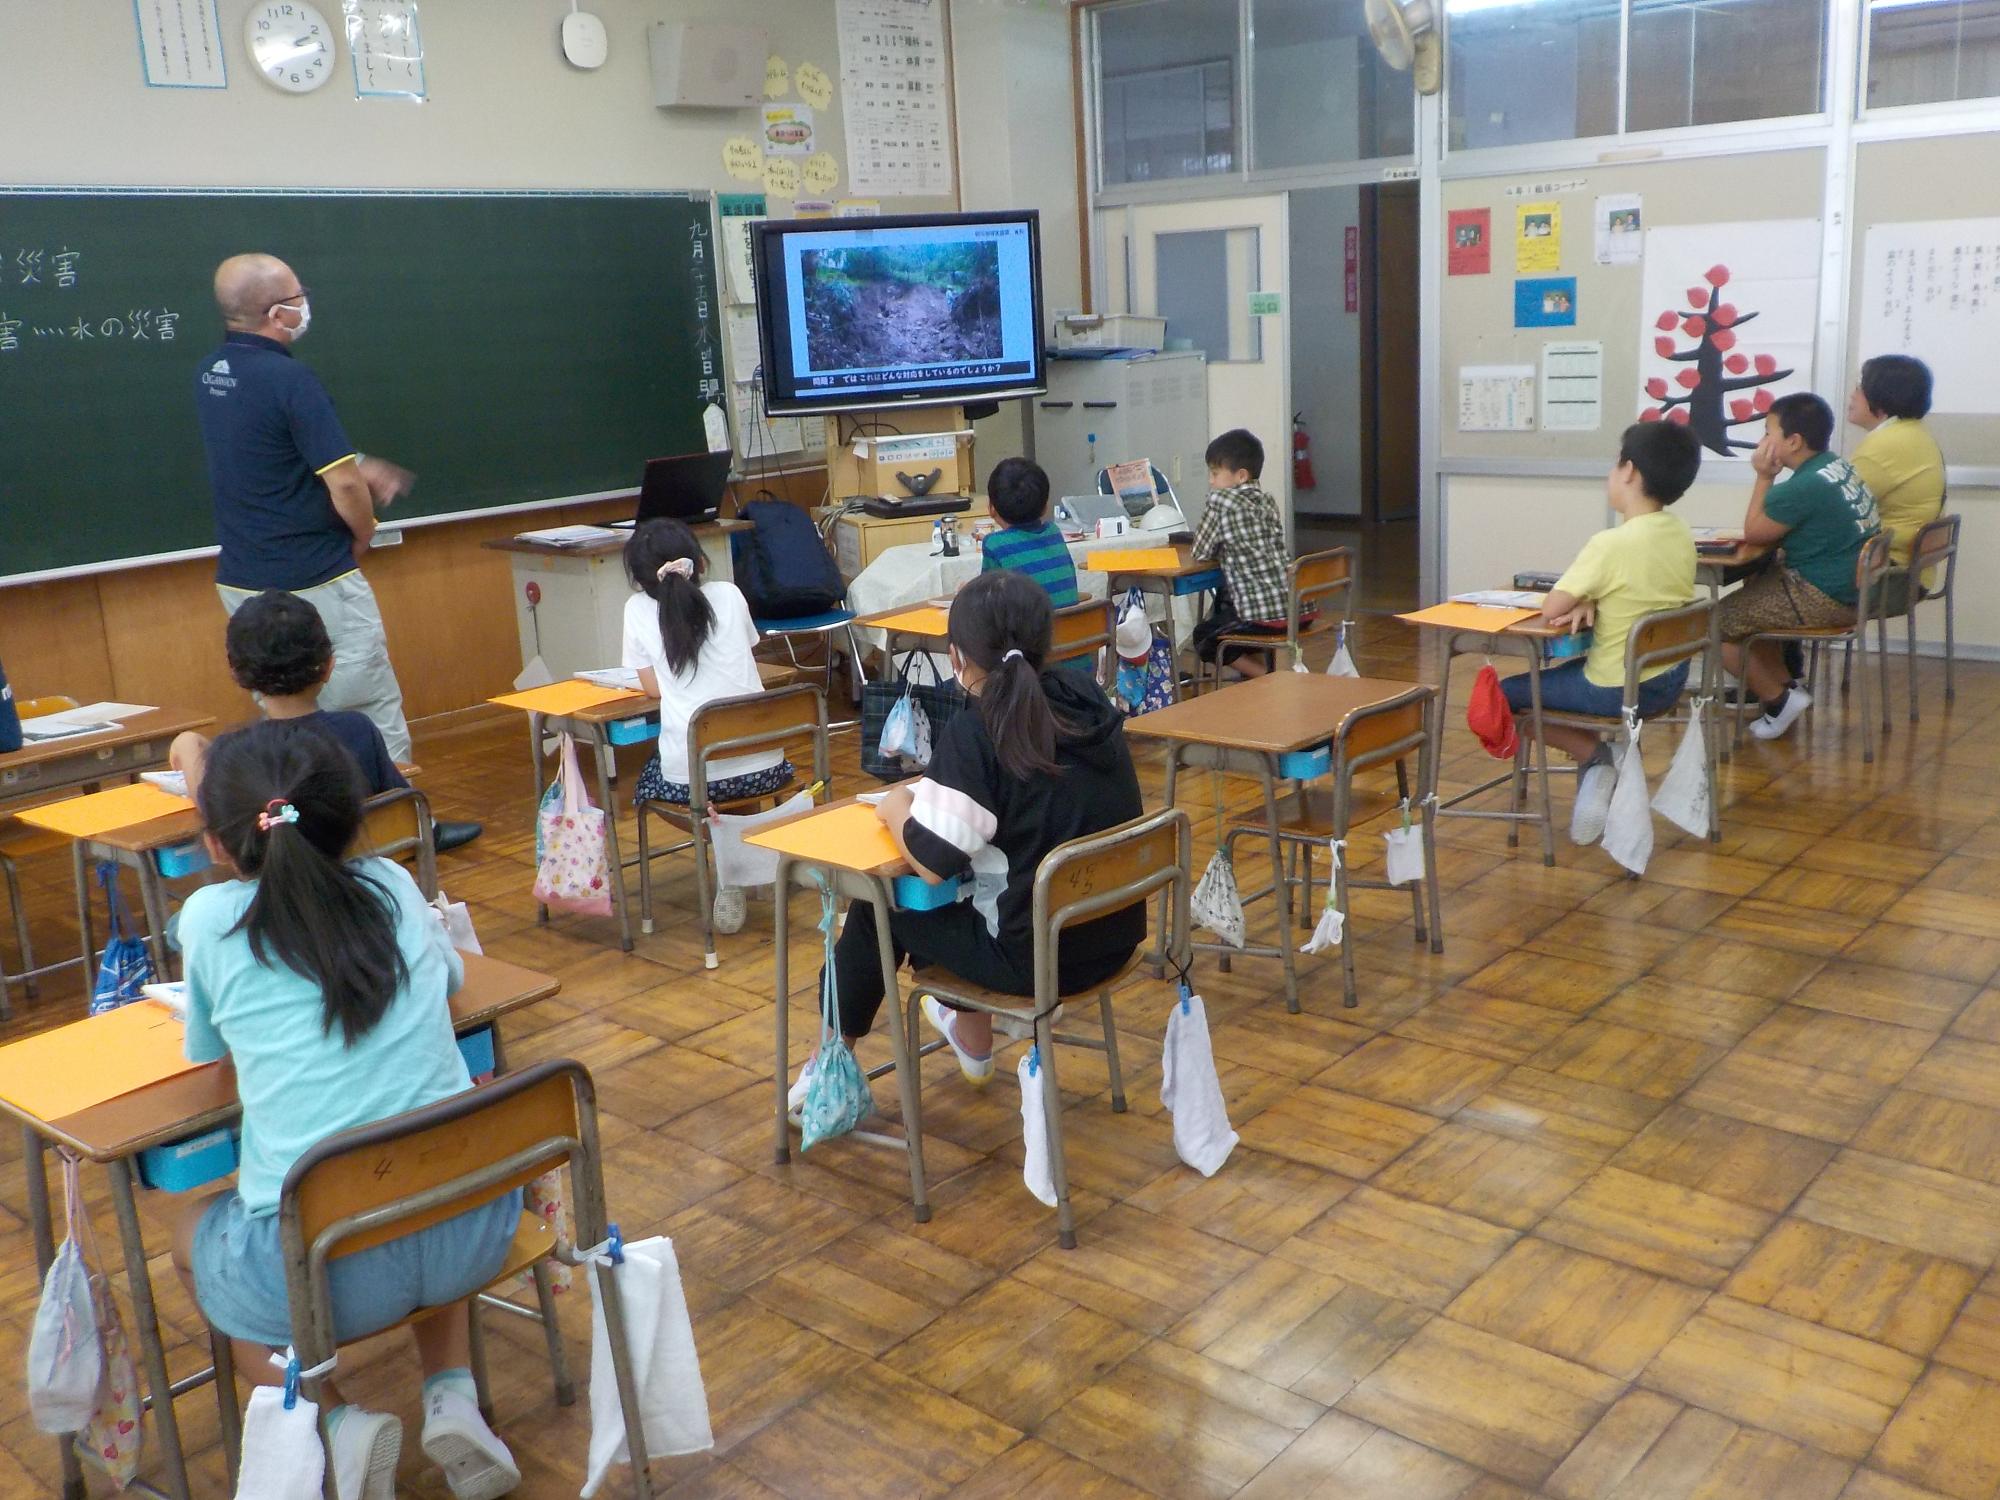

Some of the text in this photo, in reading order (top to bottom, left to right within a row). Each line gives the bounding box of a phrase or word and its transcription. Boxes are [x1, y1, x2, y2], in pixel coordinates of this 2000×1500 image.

[268, 8, 279, 18] 11
[281, 5, 293, 15] 12
[301, 11, 305, 20] 1
[258, 21, 270, 30] 10
[310, 25, 318, 34] 2
[313, 58, 322, 67] 4
[275, 67, 283, 76] 7
[305, 69, 314, 78] 5
[290, 73, 299, 83] 6
[0, 246, 81, 288] 災害
[373, 1158, 393, 1181] 4
